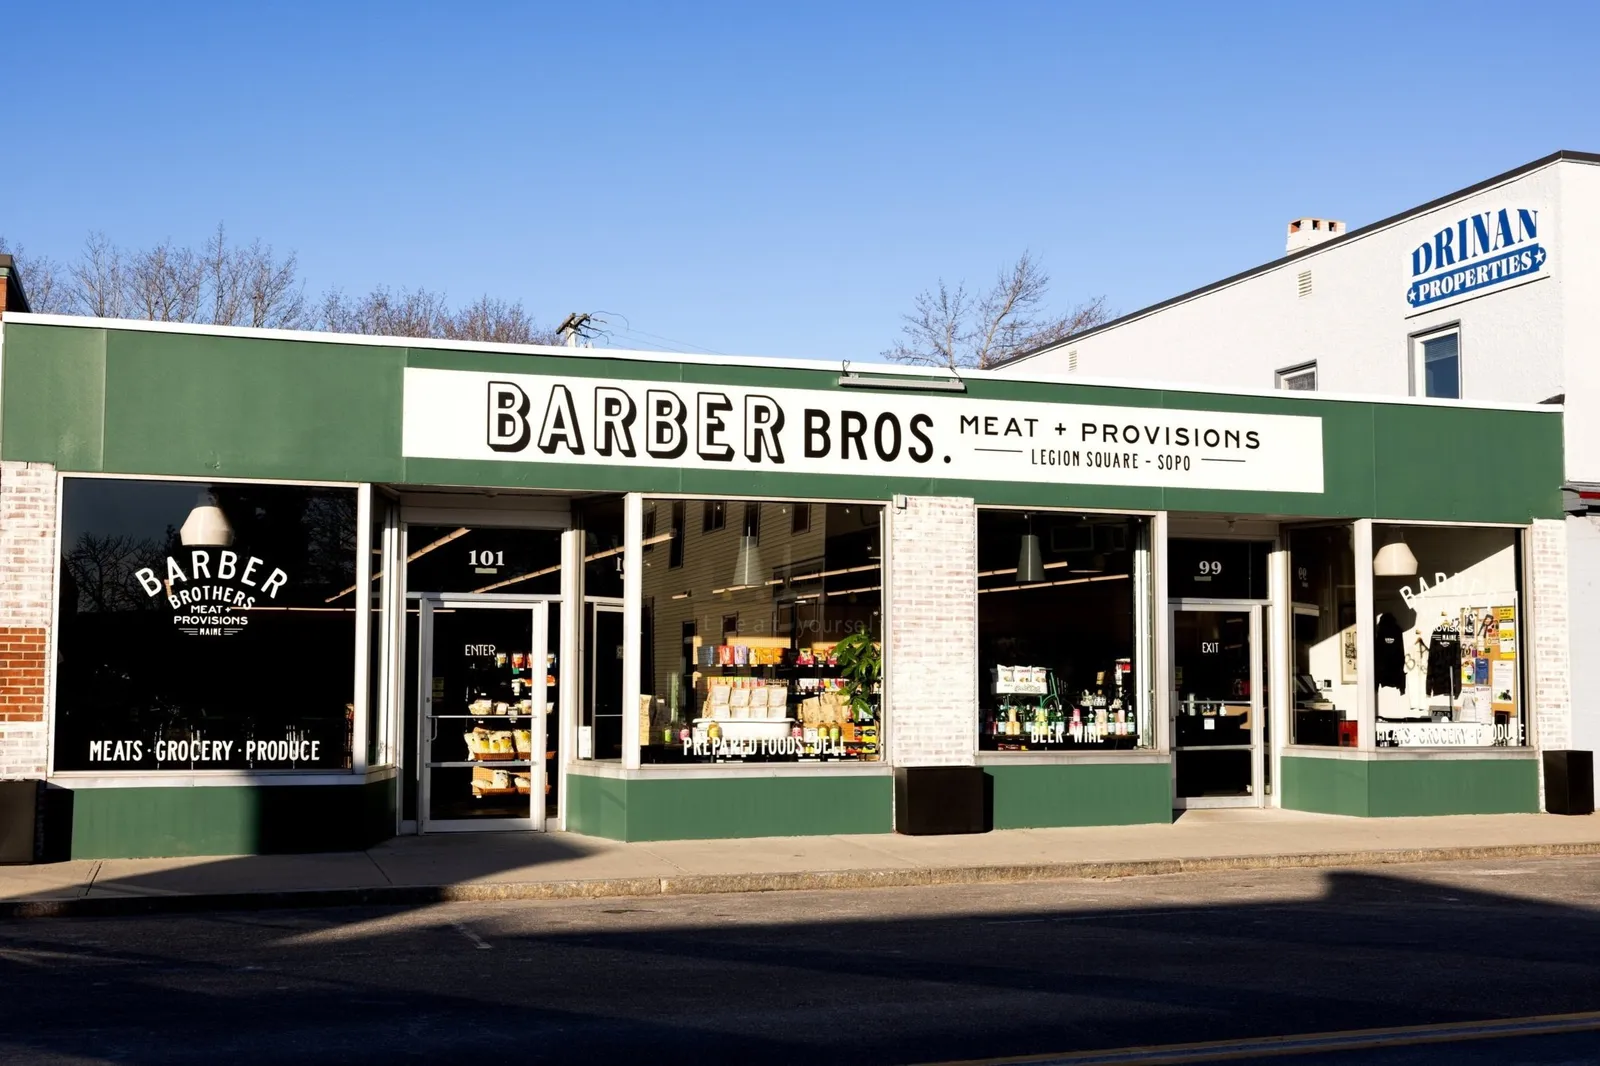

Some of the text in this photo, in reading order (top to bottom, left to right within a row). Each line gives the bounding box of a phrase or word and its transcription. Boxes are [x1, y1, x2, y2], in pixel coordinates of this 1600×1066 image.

[1411, 207, 1538, 278] DRINAN
[1419, 250, 1532, 302] PROPERTIES
[486, 380, 952, 464] BARBER BROS.
[960, 415, 1039, 438] MEAT
[1081, 422, 1261, 450] PROVISIONS
[1031, 448, 1080, 467] LEGION
[1086, 451, 1139, 469] SQUARE
[1157, 454, 1192, 472] SOPO
[468, 550, 505, 567] 101
[1198, 560, 1222, 575] 99
[135, 550, 288, 599] BARBER
[168, 585, 256, 610] BROTHERS
[1399, 572, 1497, 612] BAR
[190, 605, 223, 614] MEAT
[173, 615, 249, 626] PROVISIONS
[199, 628, 222, 636] MAINE
[464, 644, 496, 657] ENTER
[1202, 642, 1219, 654] EXIT
[1030, 725, 1064, 743] BEER
[89, 740, 143, 762] MEATS
[155, 740, 233, 762] GROCERY
[245, 740, 321, 762] PRODUCE
[683, 736, 758, 756] PREPARED
[761, 735, 804, 756] FOODS
